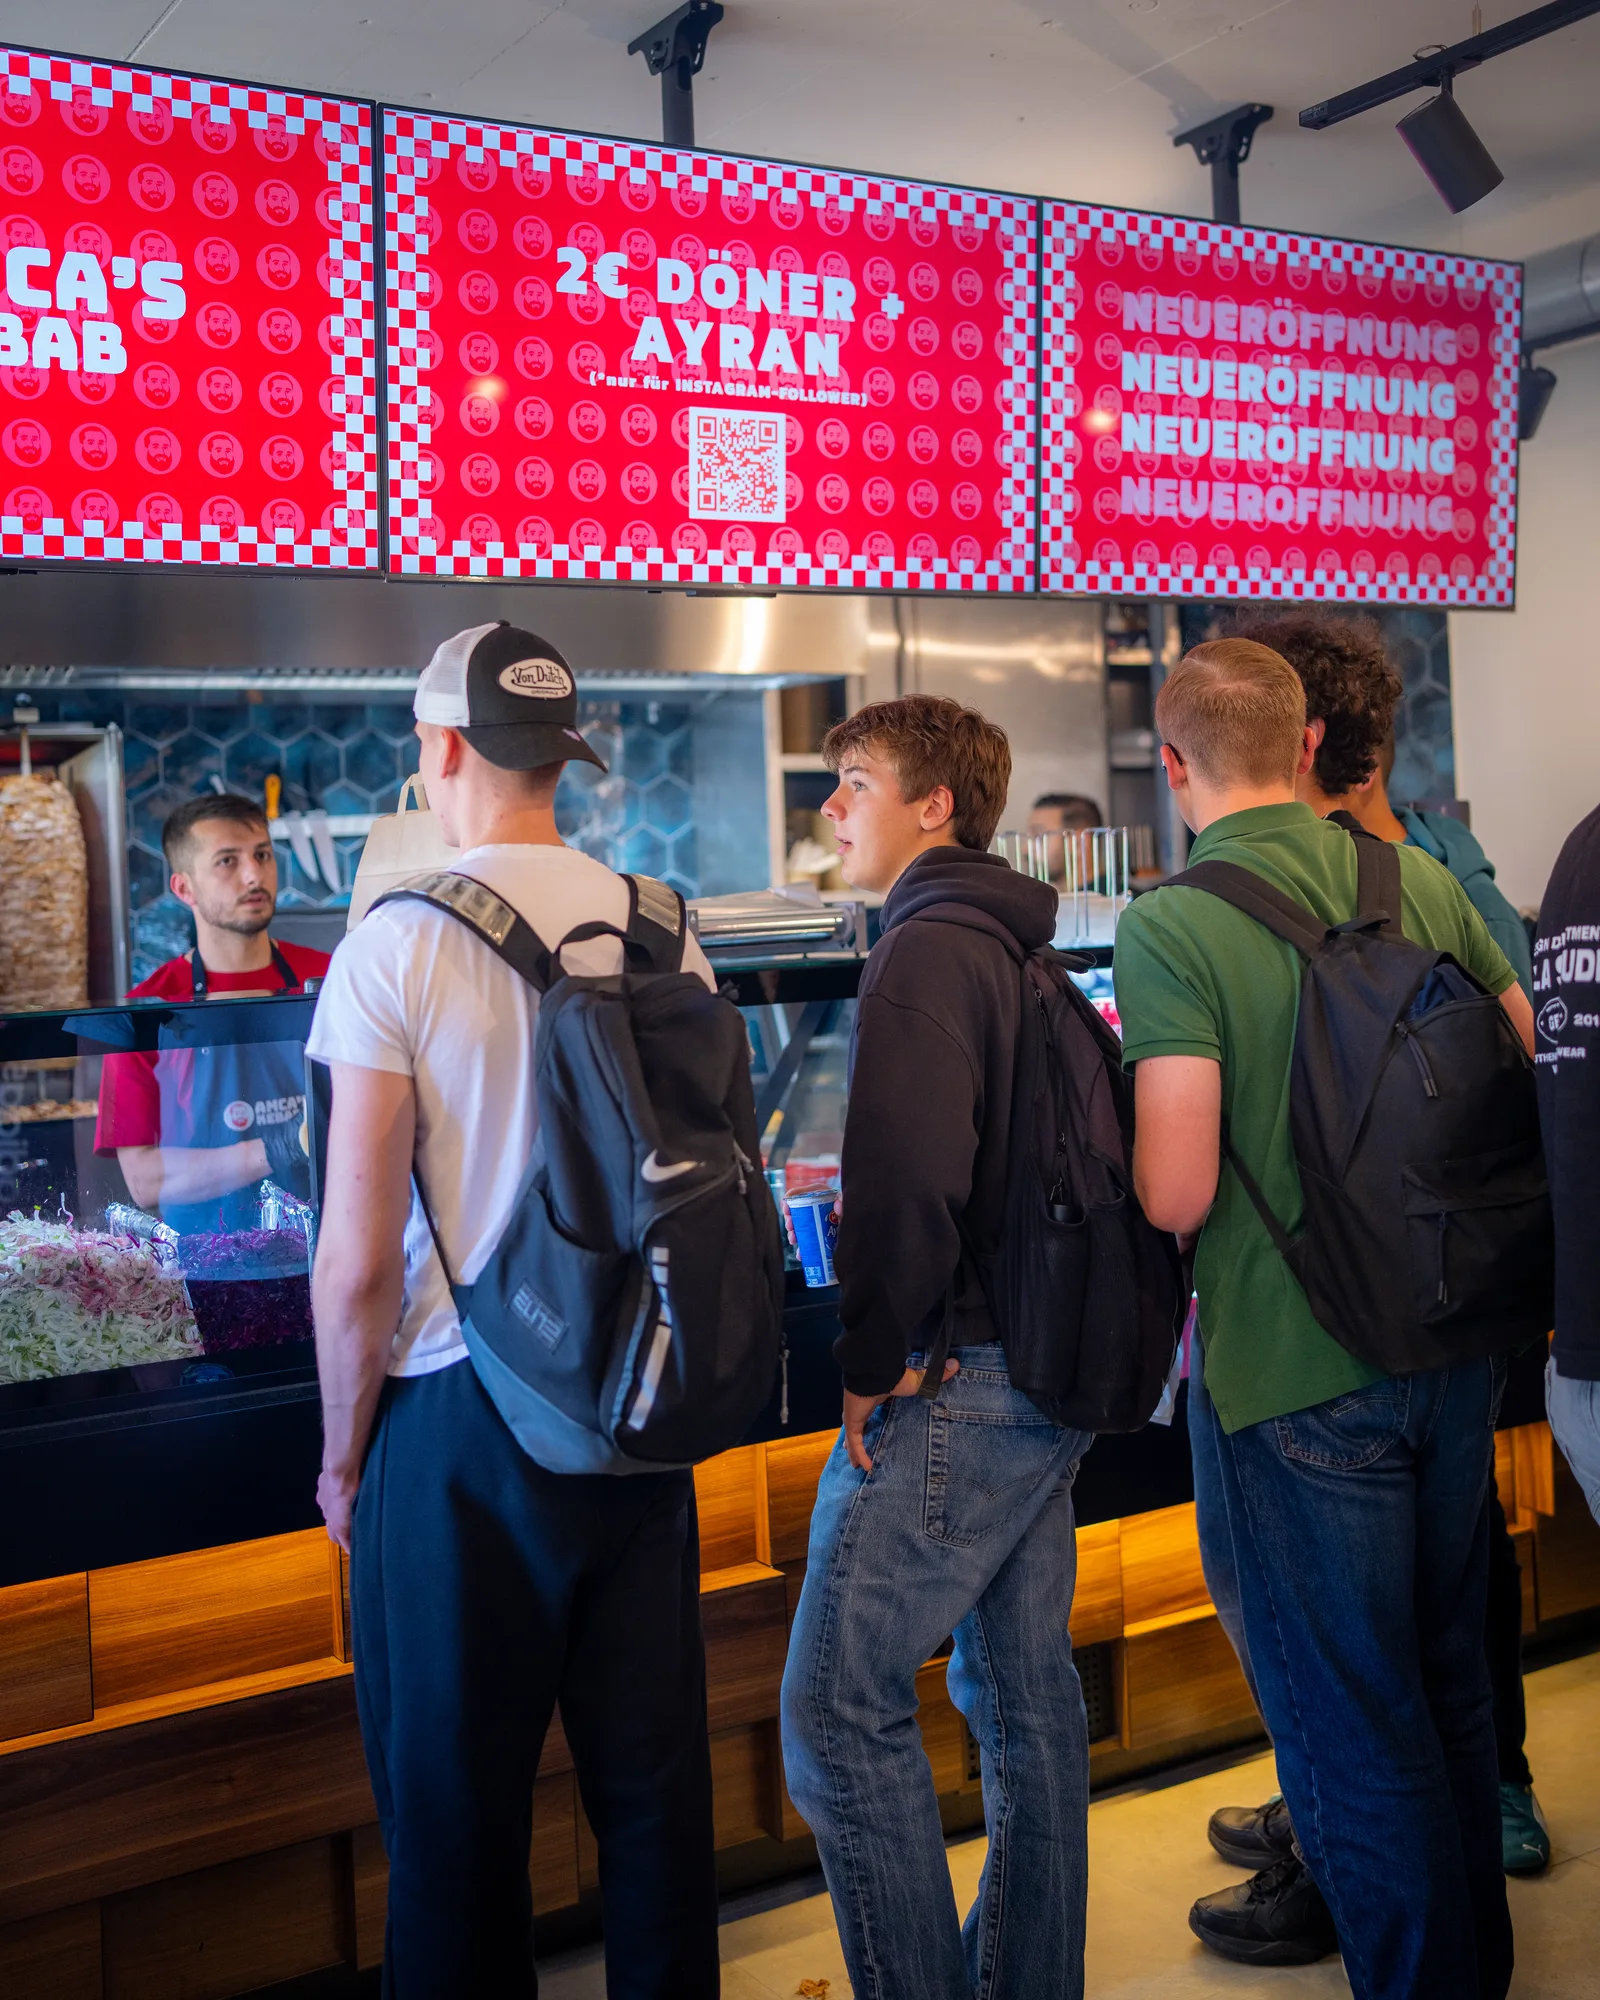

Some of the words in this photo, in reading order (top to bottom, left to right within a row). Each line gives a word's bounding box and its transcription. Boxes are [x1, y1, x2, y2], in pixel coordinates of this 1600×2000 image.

[556, 247, 628, 298] 2€
[656, 249, 856, 322] DÖNER
[881, 293, 904, 320] +
[631, 316, 839, 377] AYRAN
[1122, 291, 1457, 365] NEUERÖFFNUNG
[643, 375, 669, 390] für
[676, 378, 868, 407] INSTAGRAM-FOLLOWER)
[1121, 351, 1456, 420] NEUERÖFFNUNG
[1121, 411, 1455, 475] NEUERÖFFNUNG
[1120, 474, 1454, 533] NEUERÖFFNUNG
[511, 666, 536, 685] Von
[536, 664, 566, 687] Dutch
